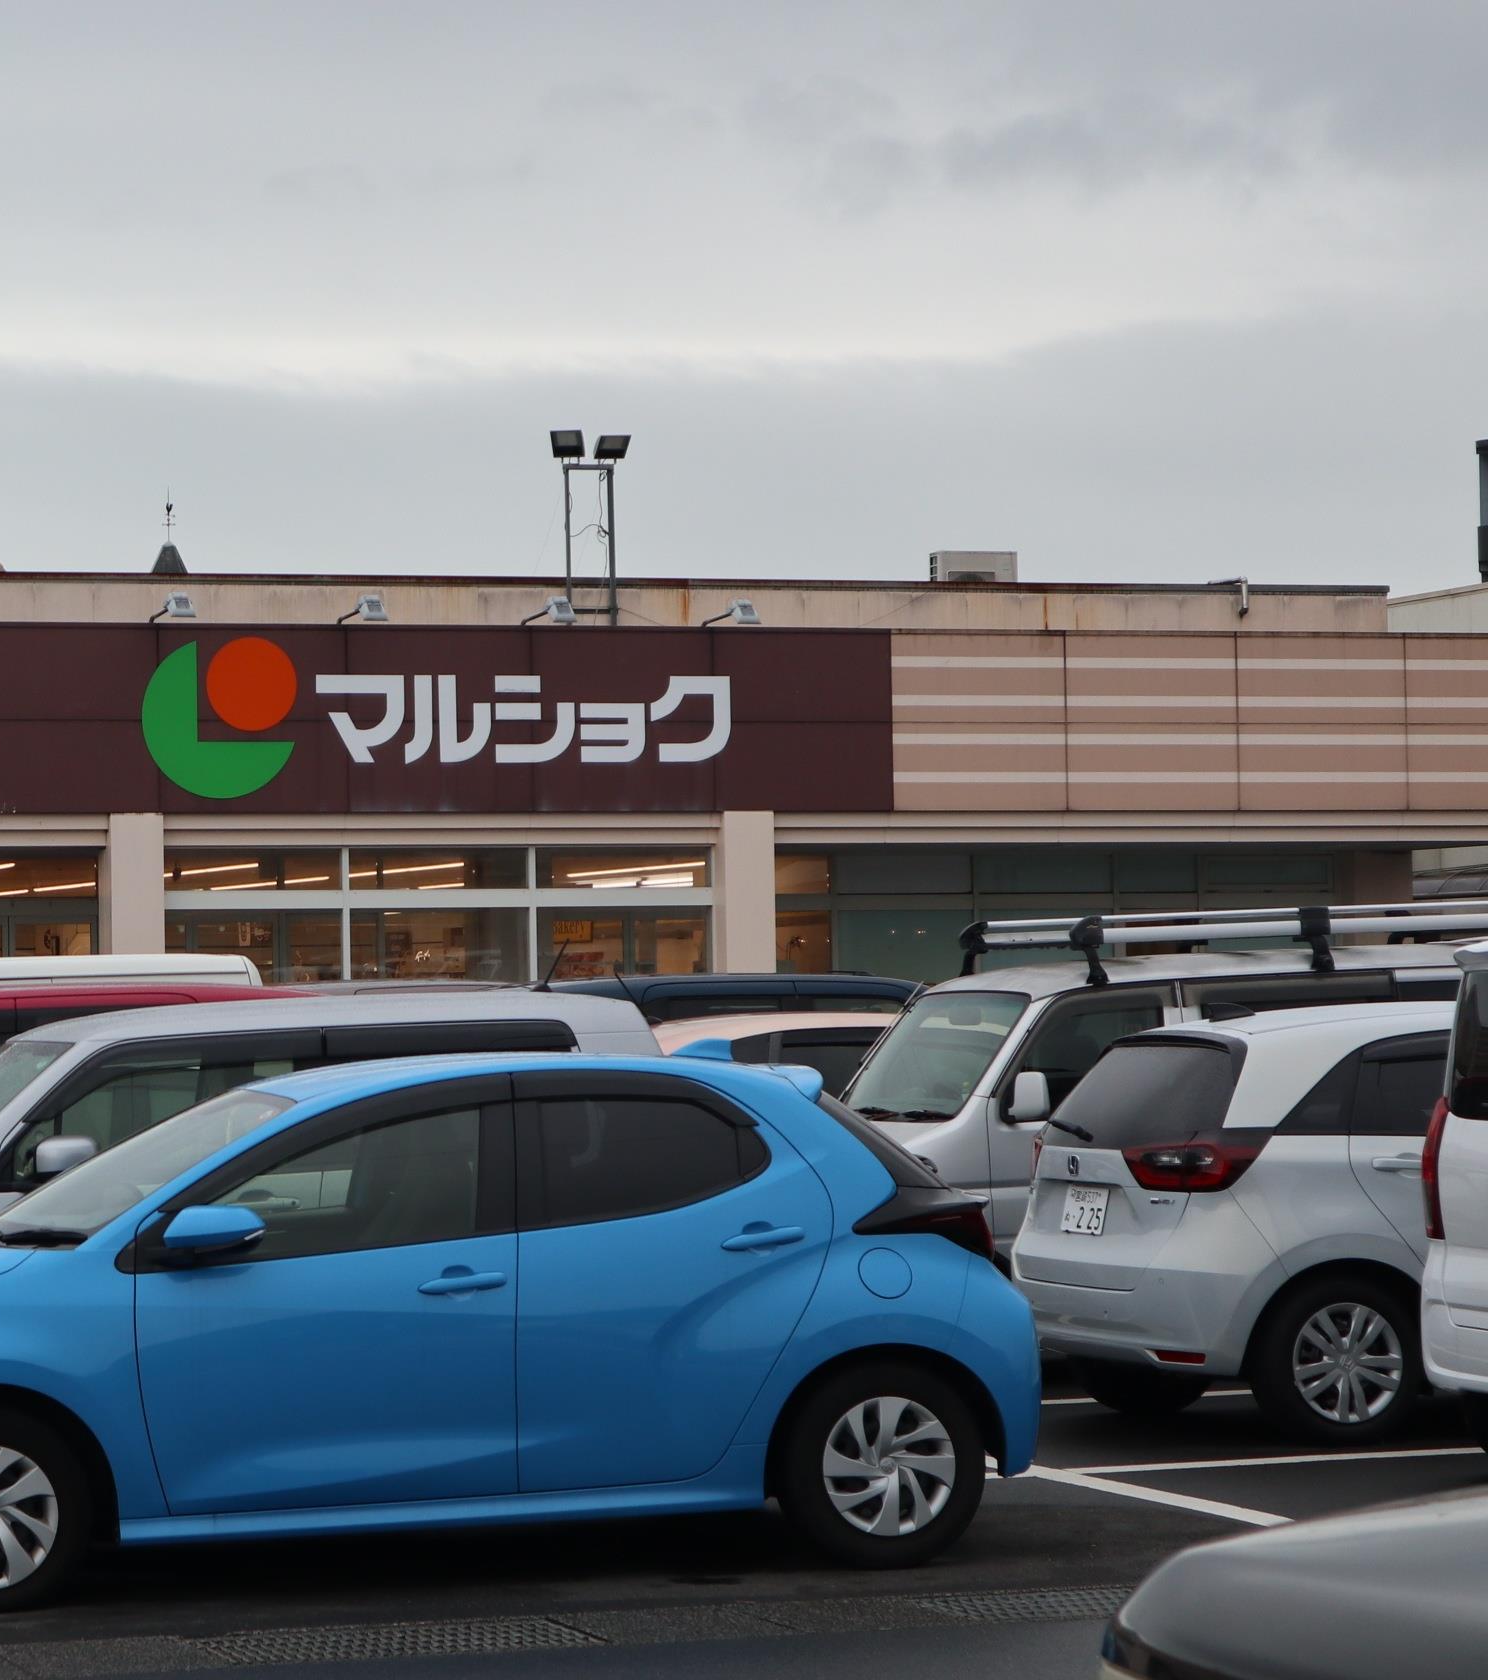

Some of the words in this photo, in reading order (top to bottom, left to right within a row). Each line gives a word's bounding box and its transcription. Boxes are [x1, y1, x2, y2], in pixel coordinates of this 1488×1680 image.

[315, 674, 731, 765] マルショク
